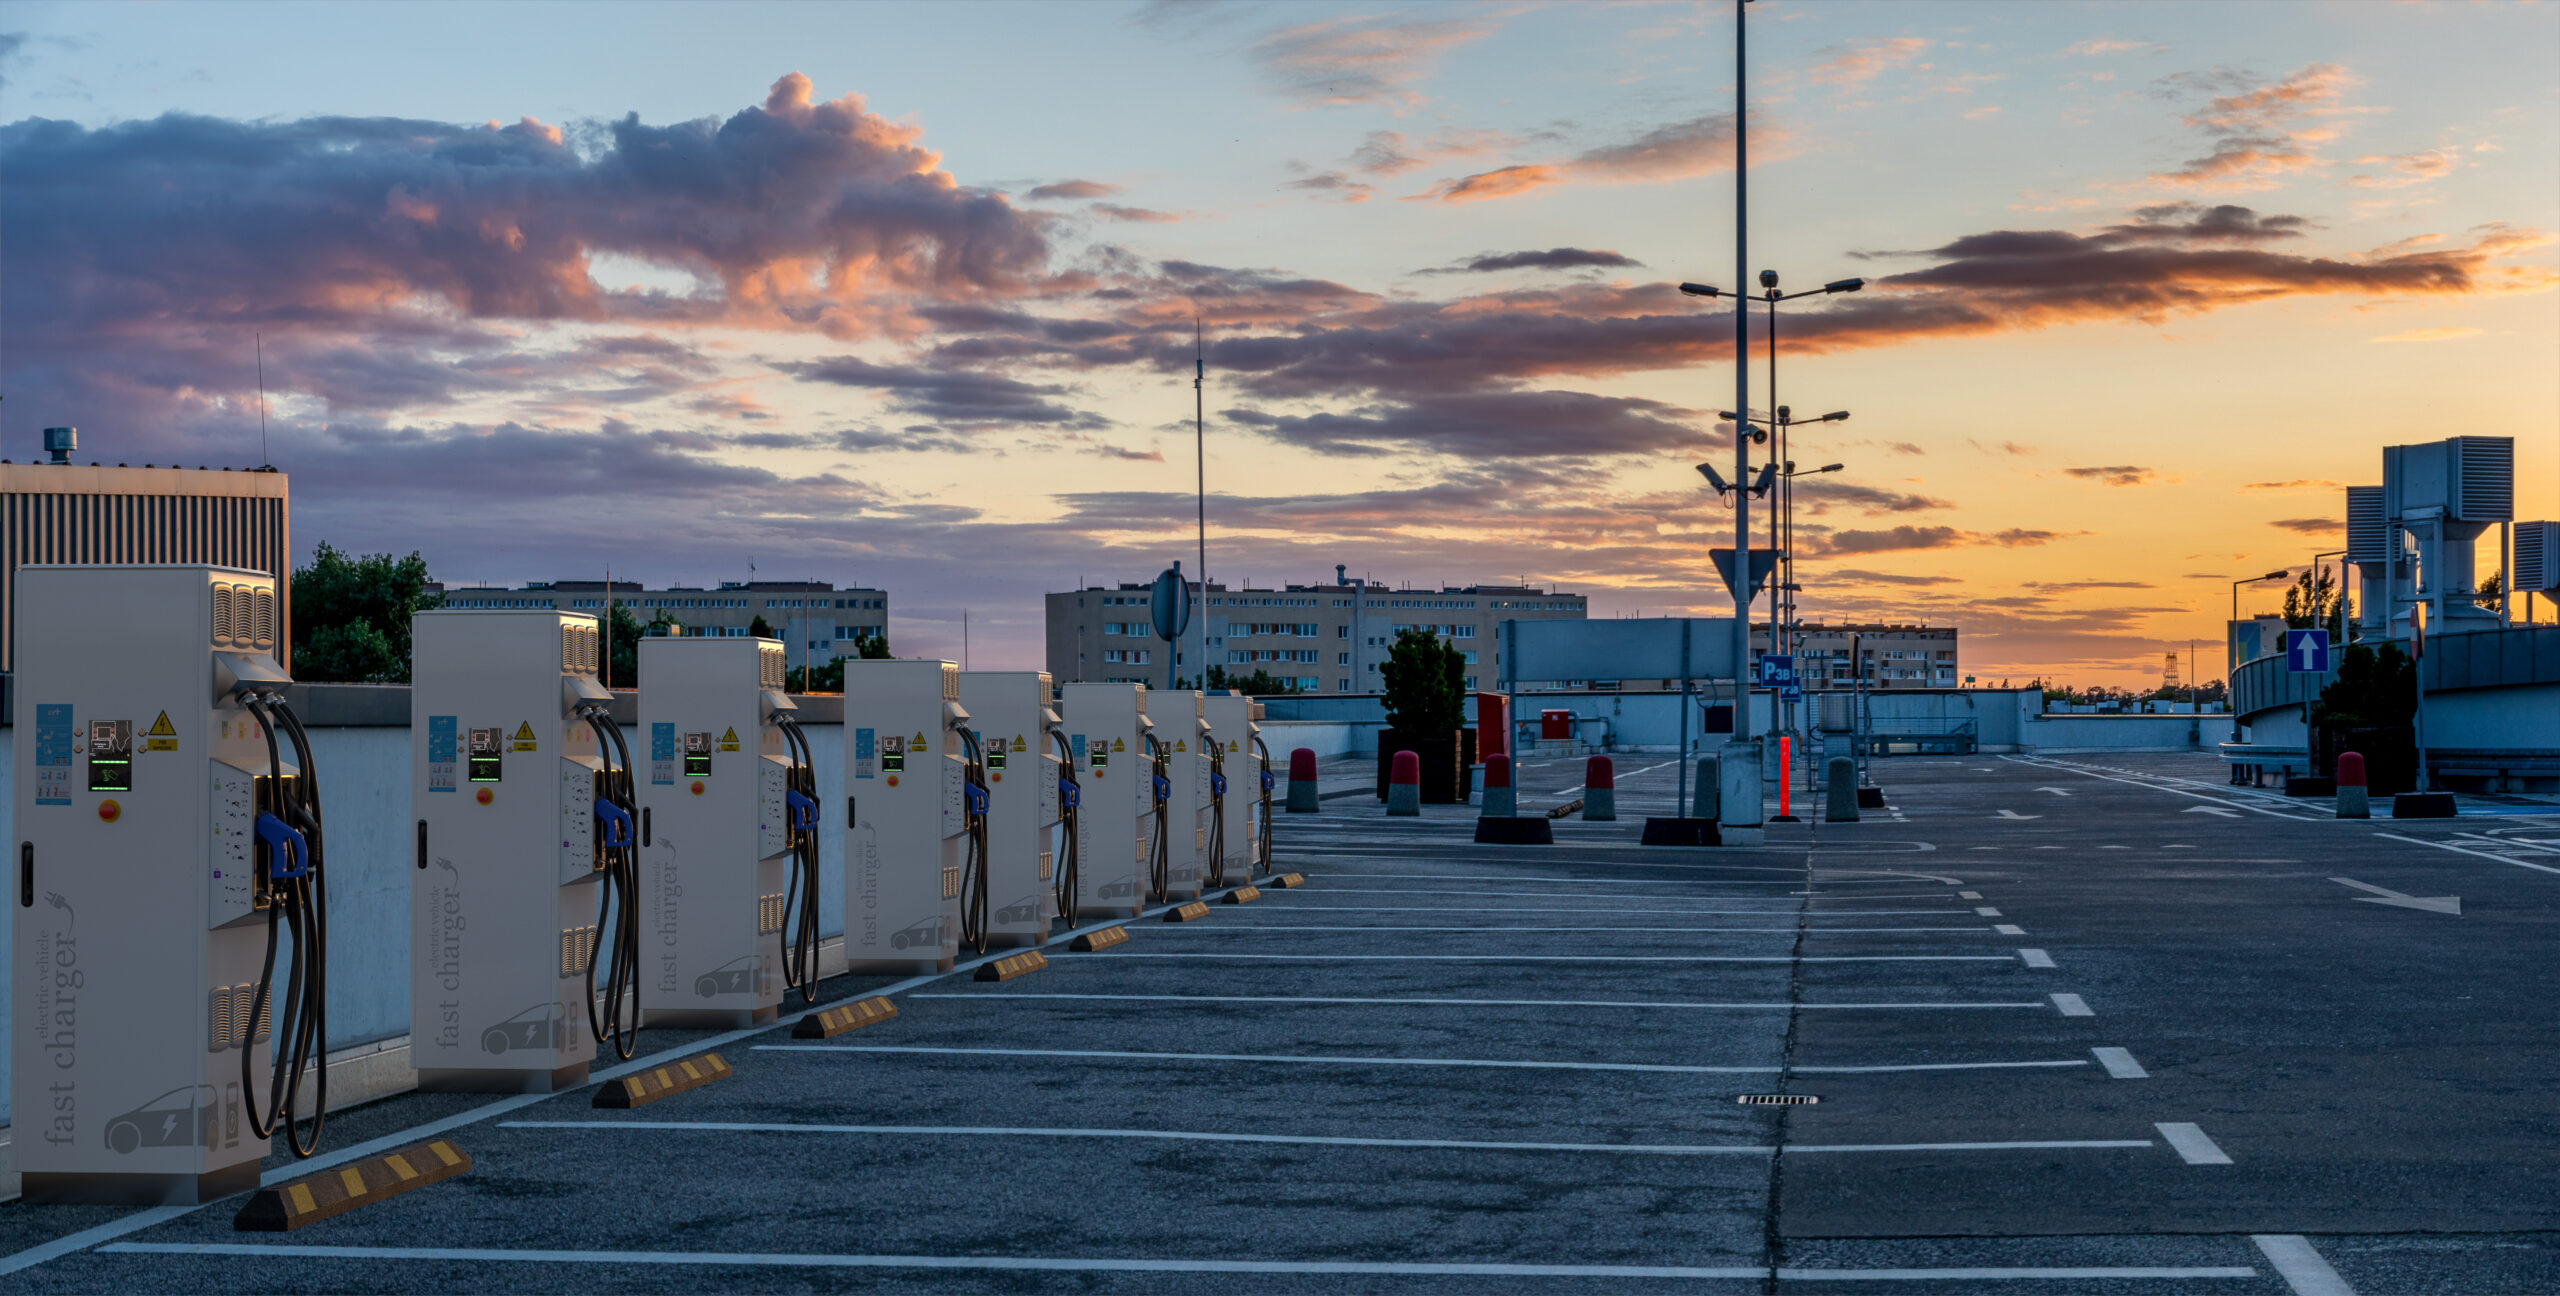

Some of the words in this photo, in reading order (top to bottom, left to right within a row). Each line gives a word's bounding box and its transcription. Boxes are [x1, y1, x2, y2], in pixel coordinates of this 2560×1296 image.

[657, 861, 683, 946] charger
[860, 839, 881, 909] charger
[35, 928, 49, 982] vehicle
[435, 887, 466, 991] charger
[860, 914, 877, 947] fast
[45, 932, 84, 1070] charger
[657, 952, 678, 994] fast
[34, 985, 49, 1039] electric
[435, 1000, 460, 1050] fast
[44, 1081, 75, 1148] fast
